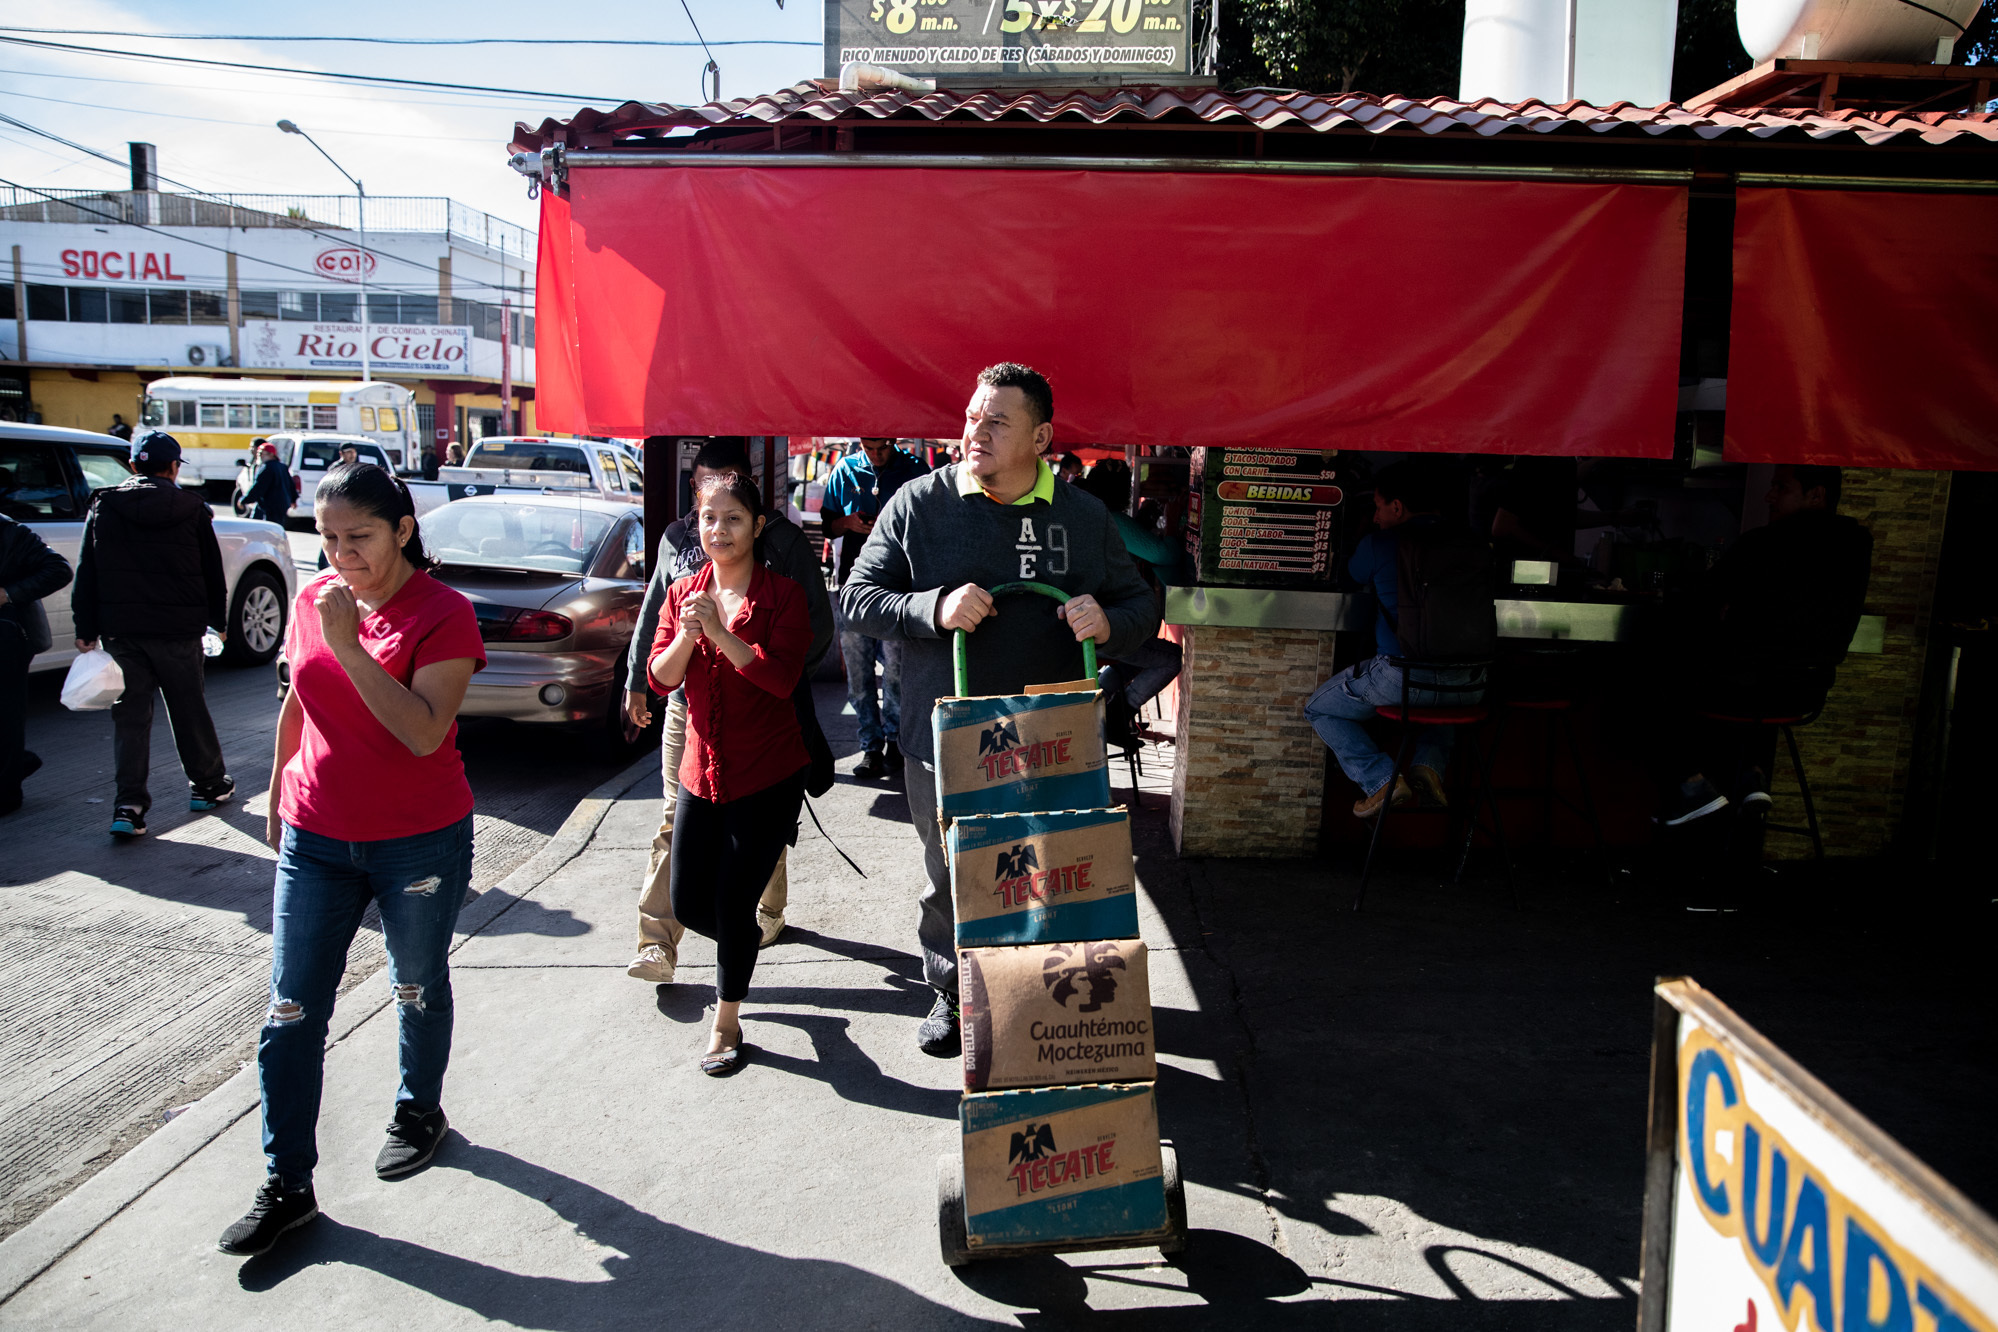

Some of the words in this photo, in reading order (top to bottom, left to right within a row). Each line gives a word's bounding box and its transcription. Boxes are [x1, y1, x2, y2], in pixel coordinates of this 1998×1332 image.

[841, 48, 871, 63] RICO
[872, 48, 926, 63] MENUDO
[927, 48, 938, 63] Y
[939, 48, 979, 63] CALDO
[980, 48, 1000, 63] DE
[1000, 48, 1023, 63] RES
[1088, 48, 1101, 63] Y
[1101, 47, 1176, 65] DOMINGOS)
[61, 249, 186, 281] SOCIAL
[377, 326, 390, 334] DE
[391, 326, 427, 335] COMIDA
[294, 334, 357, 359] Rio
[371, 336, 464, 361] Cielo
[1224, 453, 1232, 464] 5
[1232, 454, 1257, 465] TACOS
[1257, 455, 1297, 466] DORADOS
[1223, 466, 1241, 476] CON
[1241, 467, 1268, 478] CARNE
[1319, 469, 1336, 480] $50
[1246, 485, 1313, 502] BEBIDAS
[1223, 506, 1256, 517] TONICOL
[1315, 510, 1332, 521] $15
[1221, 517, 1249, 527] SODAS
[1314, 520, 1331, 531] $15
[1220, 528, 1243, 538] AGUA
[1244, 529, 1257, 538] DE
[1256, 529, 1285, 539] SABOR
[1313, 530, 1330, 541] $15
[1047, 523, 1069, 576] 9
[1220, 539, 1247, 549] JUGOS
[1312, 541, 1329, 552] $15
[1312, 552, 1327, 562] $12
[1218, 559, 1242, 569] AGUA
[1242, 560, 1280, 570] NATURAL
[1311, 562, 1326, 574] $12
[977, 737, 1073, 781] TECATE
[993, 862, 1094, 908] TECATE
[1034, 911, 1057, 923] LIGHT
[962, 956, 973, 1003] BOTELLAS
[1030, 1018, 1149, 1041] Cuauhtémoc
[964, 1022, 976, 1070] BOTELLAS
[1037, 1040, 1145, 1066] Moctezuma
[1007, 1140, 1117, 1196] TECATE
